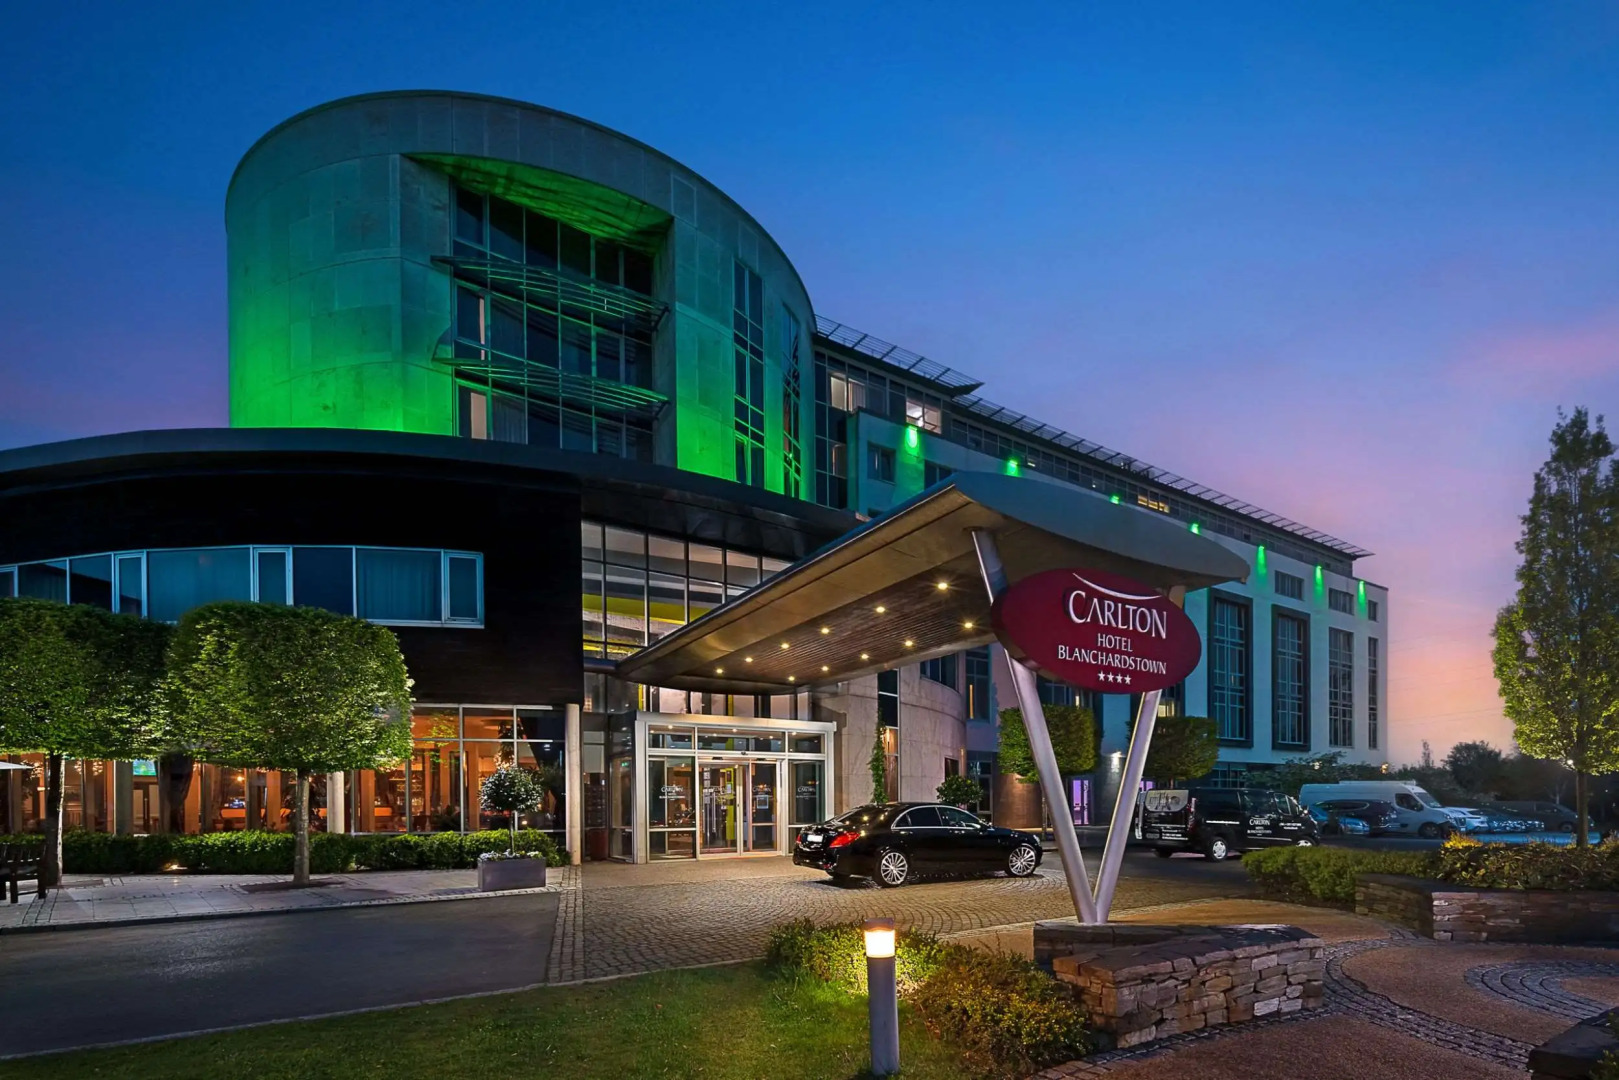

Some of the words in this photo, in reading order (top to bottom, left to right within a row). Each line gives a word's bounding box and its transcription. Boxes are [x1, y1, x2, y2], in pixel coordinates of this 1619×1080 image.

[1068, 590, 1167, 639] CARLTON
[1097, 633, 1133, 652] HOTEL
[1058, 645, 1167, 674] BLANCHARDSTOWN
